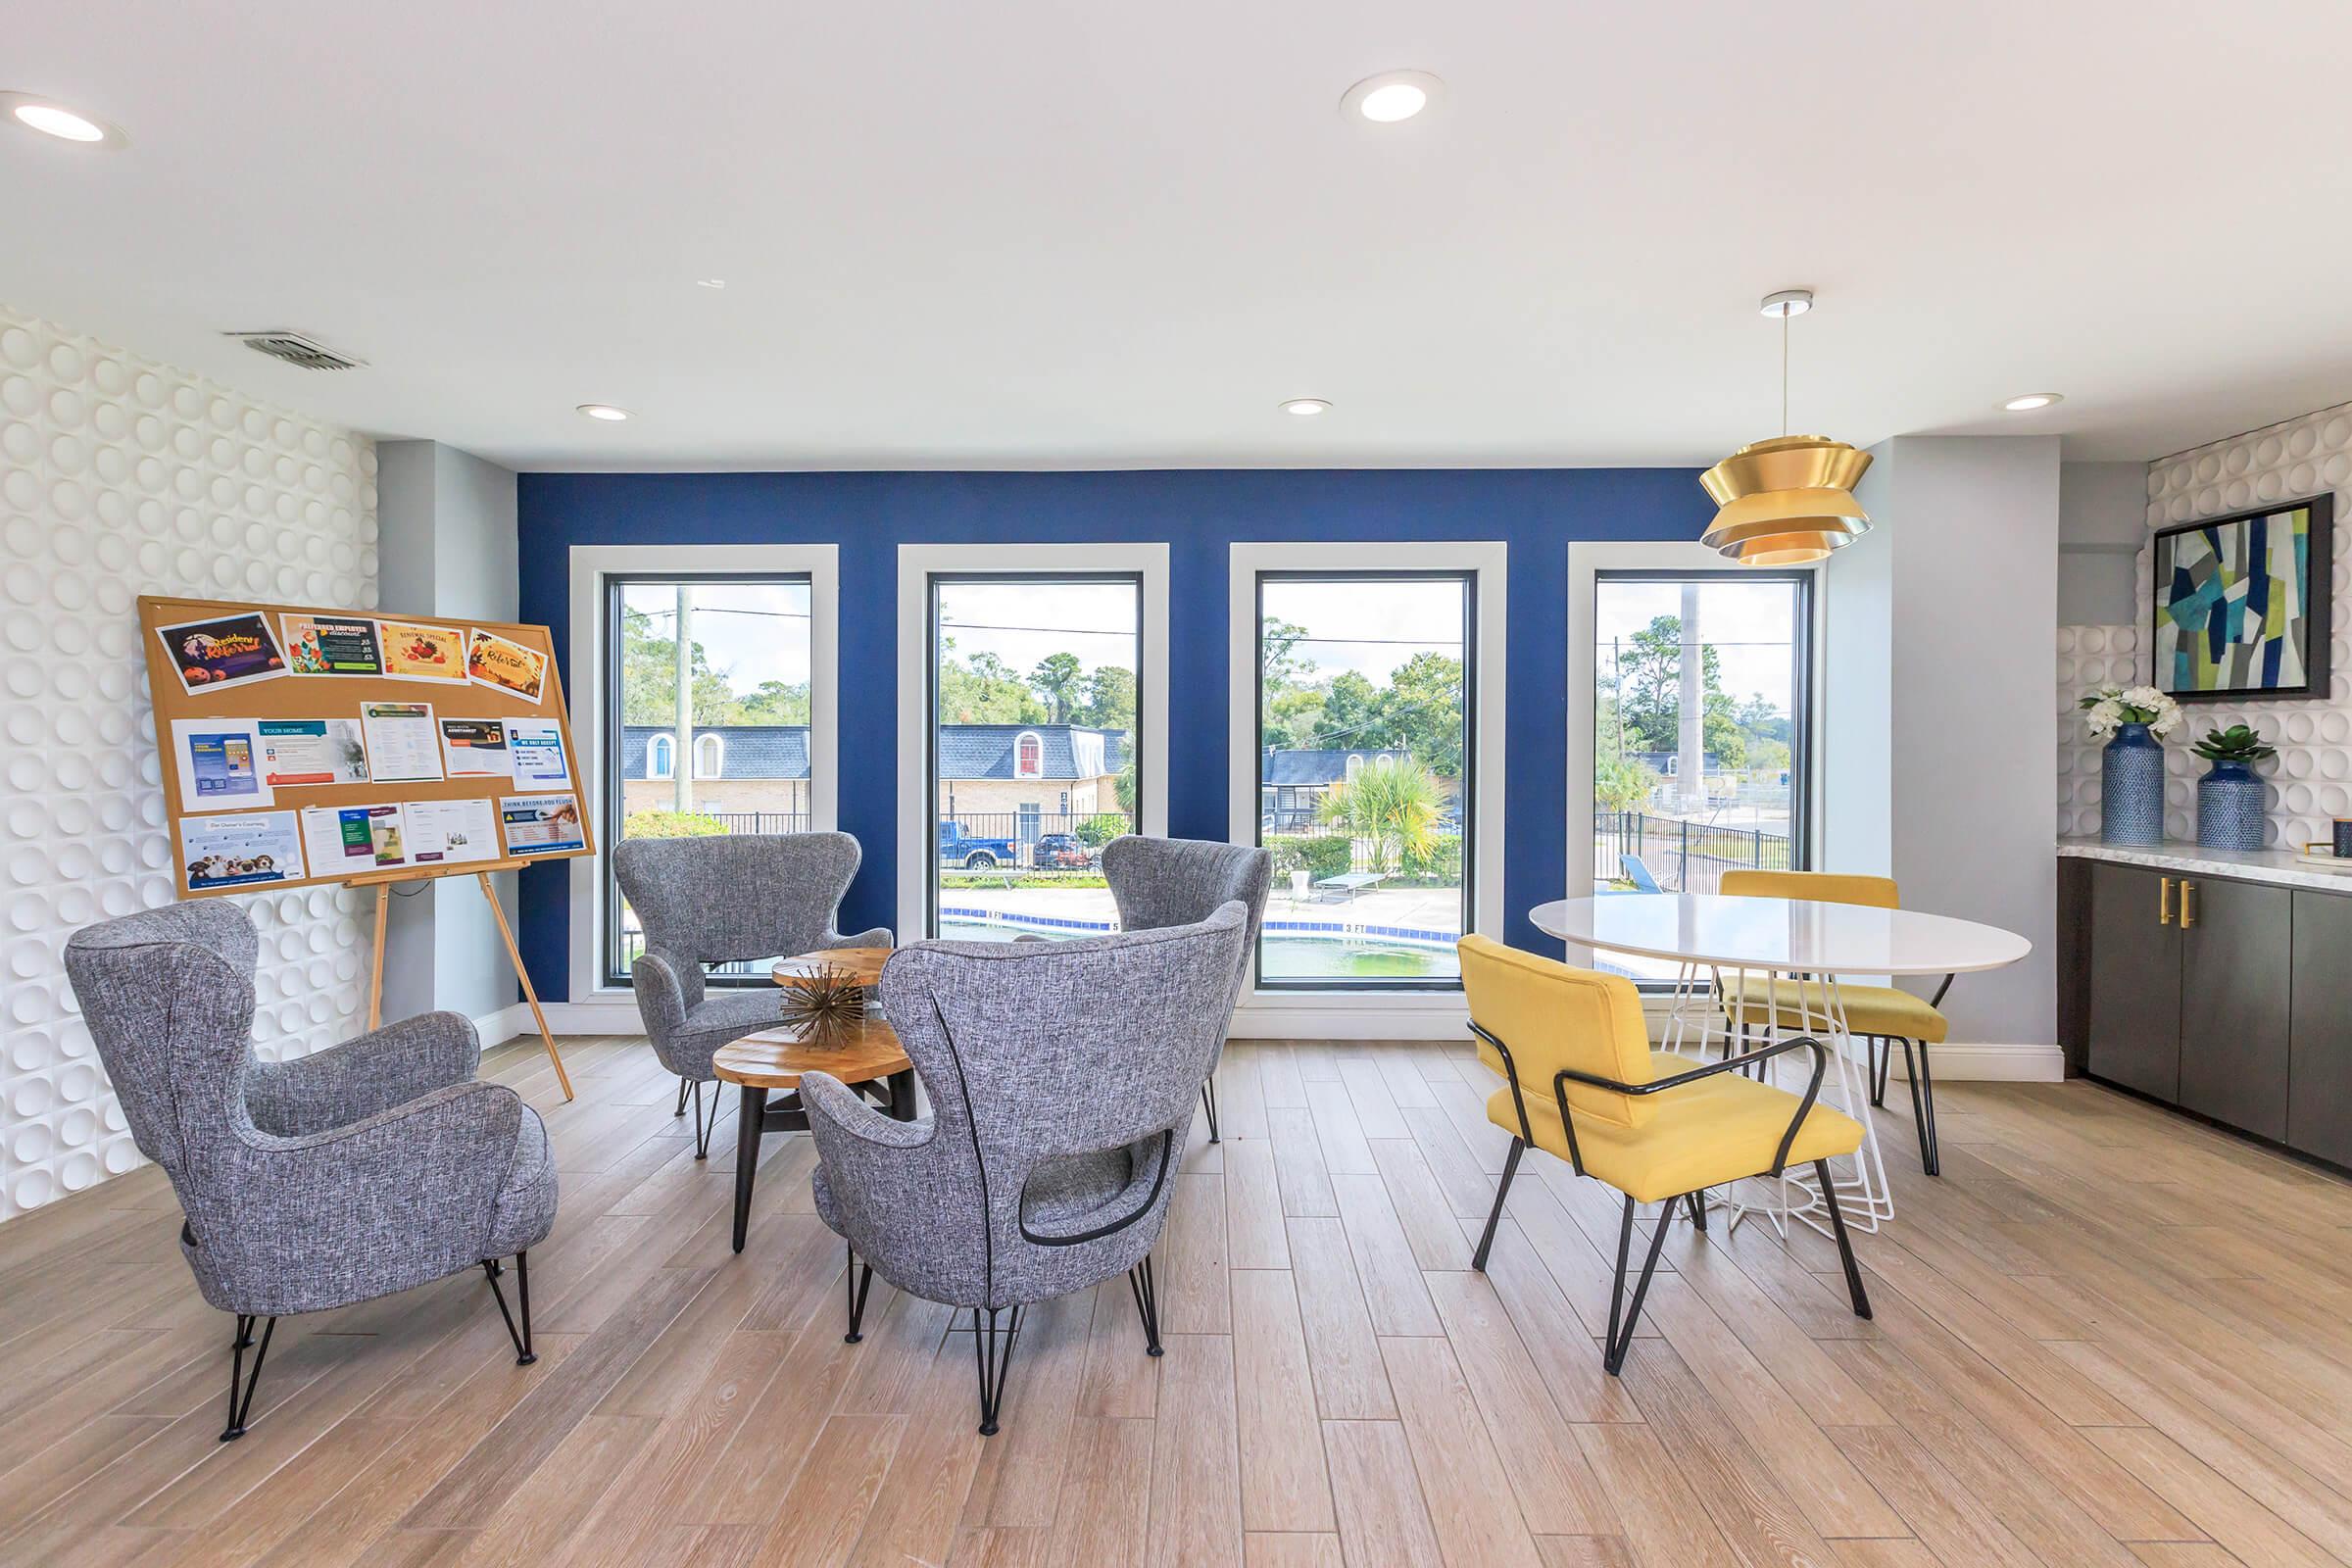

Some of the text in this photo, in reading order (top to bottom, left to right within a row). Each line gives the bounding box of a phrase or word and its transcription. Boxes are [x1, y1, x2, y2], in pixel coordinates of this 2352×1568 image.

[214, 633, 254, 648] Resident
[425, 633, 447, 642] SPECIAL
[206, 637, 260, 660] Referral
[487, 651, 522, 668] Referral
[1112, 922, 1119, 931] 5
[1346, 923, 1351, 933] 3
